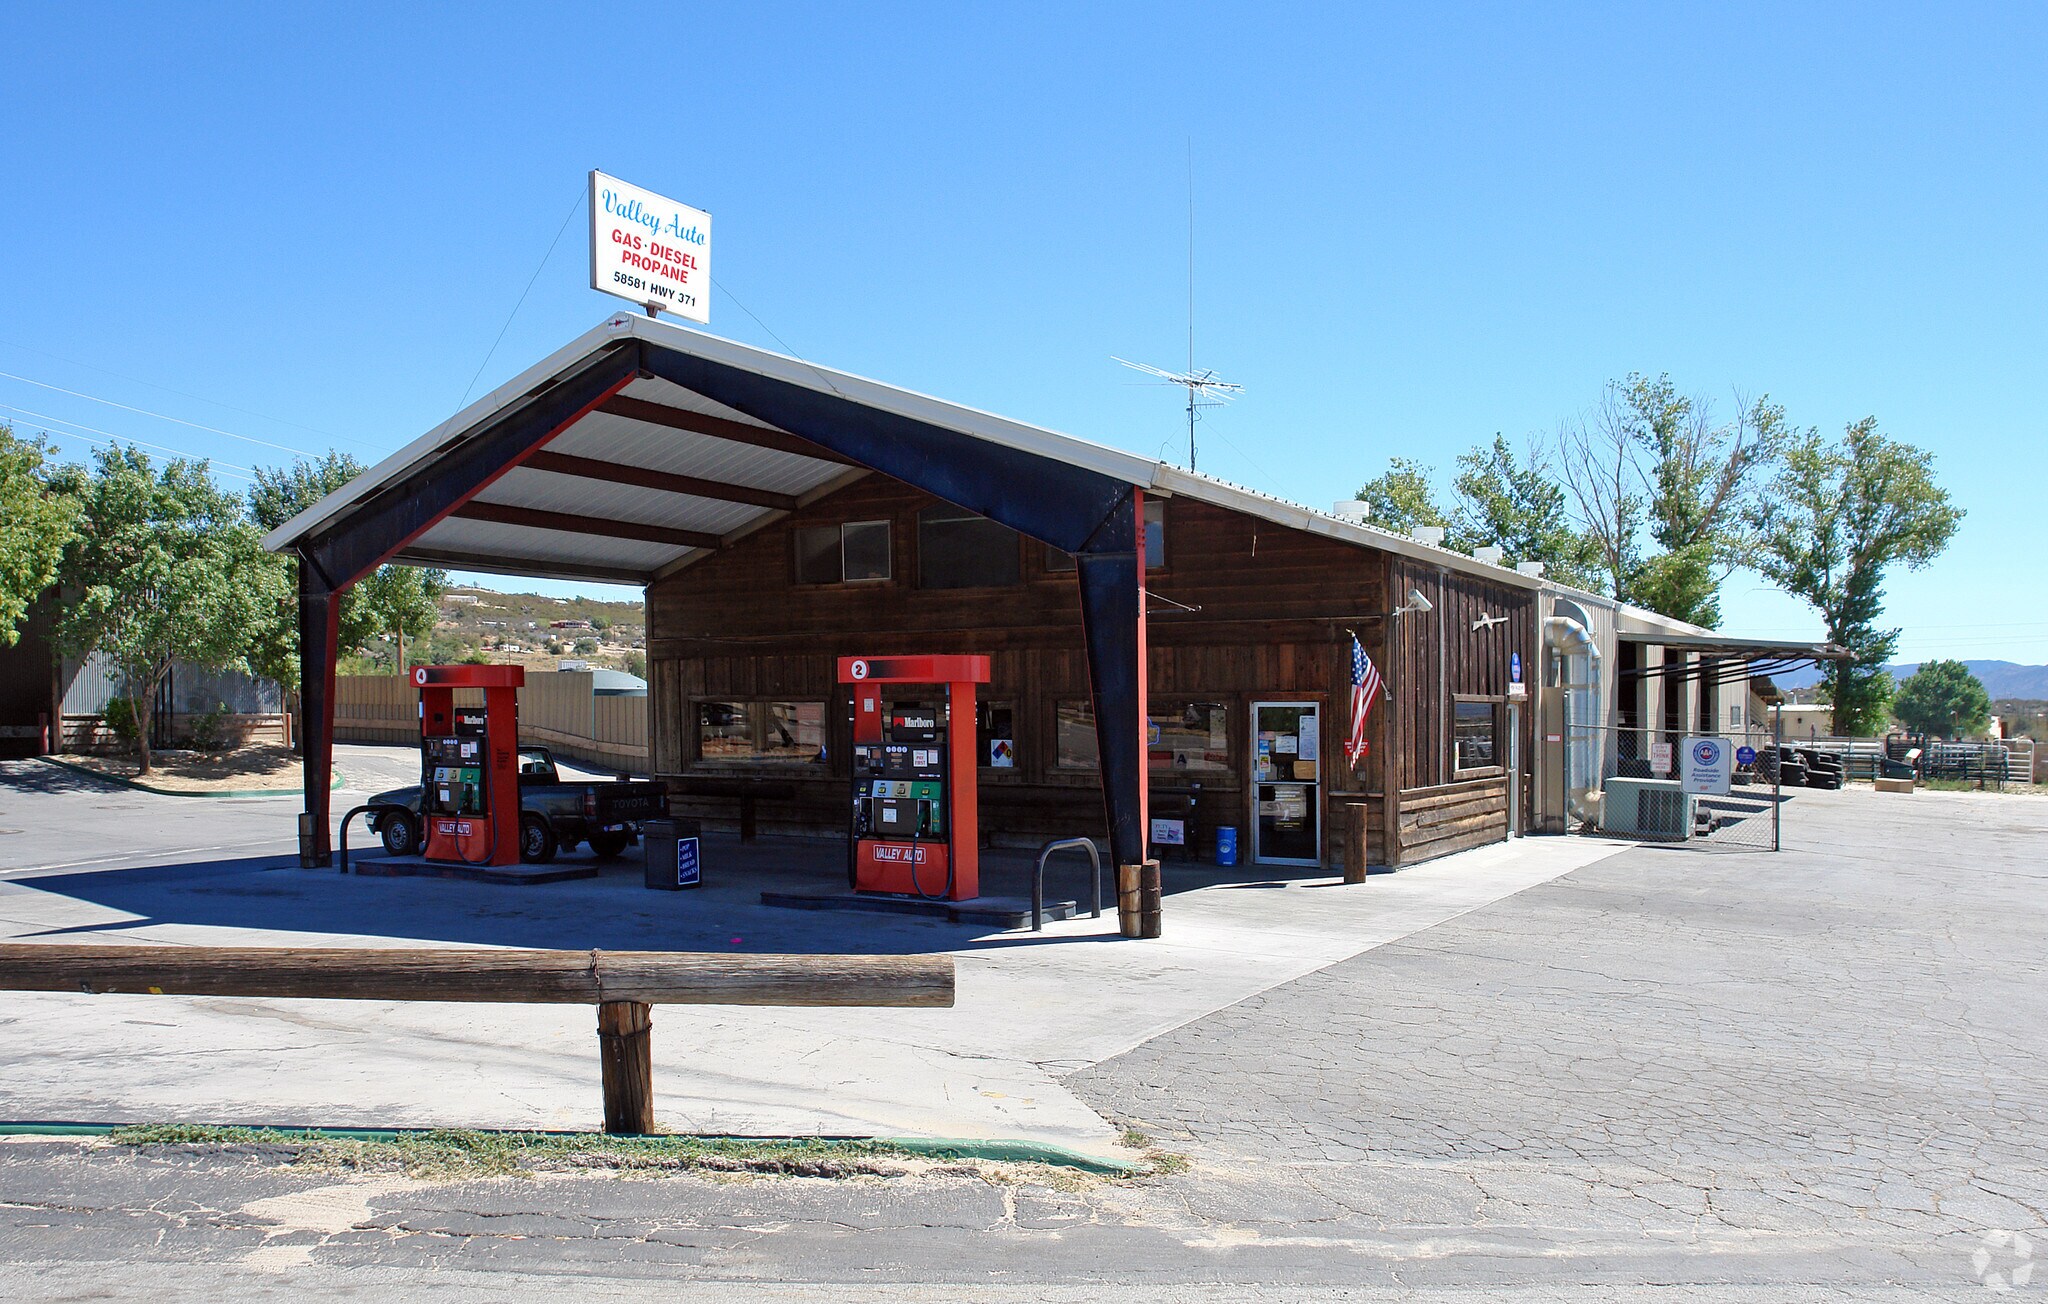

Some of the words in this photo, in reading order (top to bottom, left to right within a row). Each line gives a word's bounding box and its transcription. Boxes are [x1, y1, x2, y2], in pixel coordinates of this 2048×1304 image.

[602, 188, 662, 237] Valley
[664, 213, 706, 246] Auto
[611, 228, 642, 250] GAS
[650, 242, 698, 270] DIESEL
[621, 250, 689, 284] PROPANE
[613, 271, 646, 290] 58581
[650, 283, 675, 300] HWY
[677, 292, 696, 307] 371
[855, 664, 862, 676] 2
[904, 716, 934, 728] Marlboro
[1177, 753, 1187, 764] A
[612, 797, 649, 809] TOYOTA
[439, 823, 455, 833] VALLEY
[682, 851, 693, 861] MILK
[876, 847, 902, 860] VALLEY
[903, 849, 923, 862] AUTO
[682, 859, 696, 870] BREAD
[682, 867, 698, 878] SNACKS
